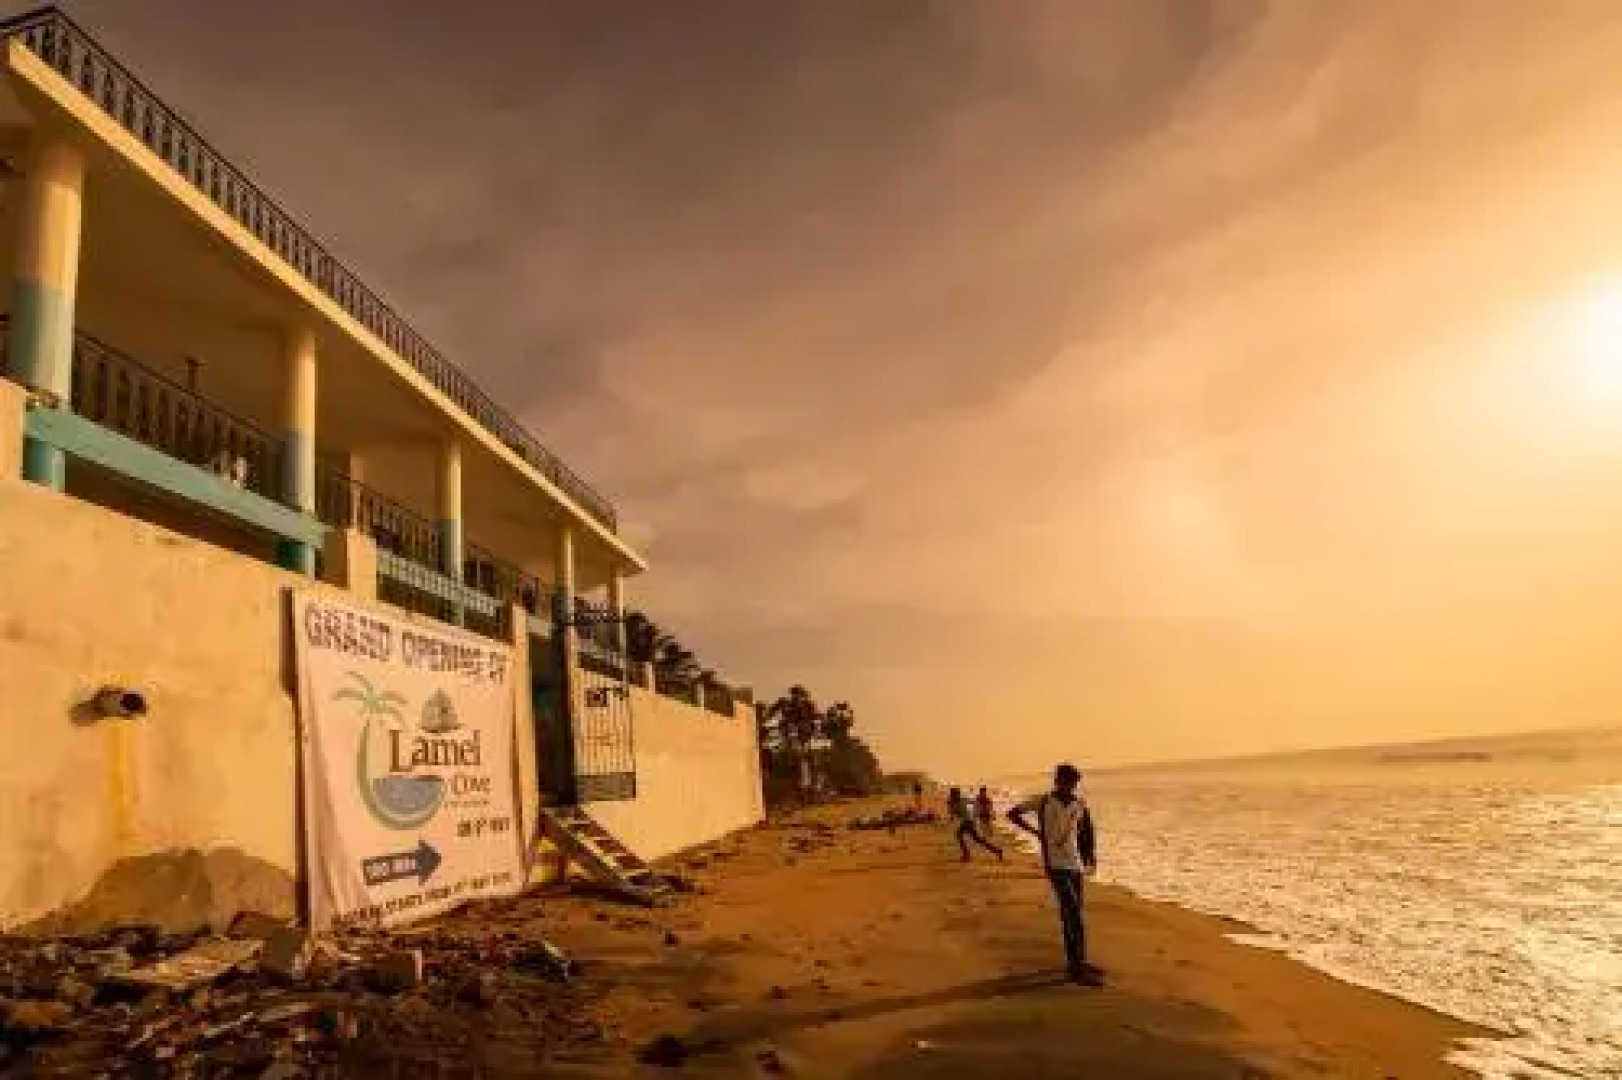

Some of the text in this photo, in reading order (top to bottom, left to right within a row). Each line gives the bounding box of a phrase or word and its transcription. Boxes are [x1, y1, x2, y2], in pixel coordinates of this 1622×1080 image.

[305, 602, 390, 662] GRAND
[402, 631, 482, 678] OPENING
[389, 730, 480, 772] Lamel
